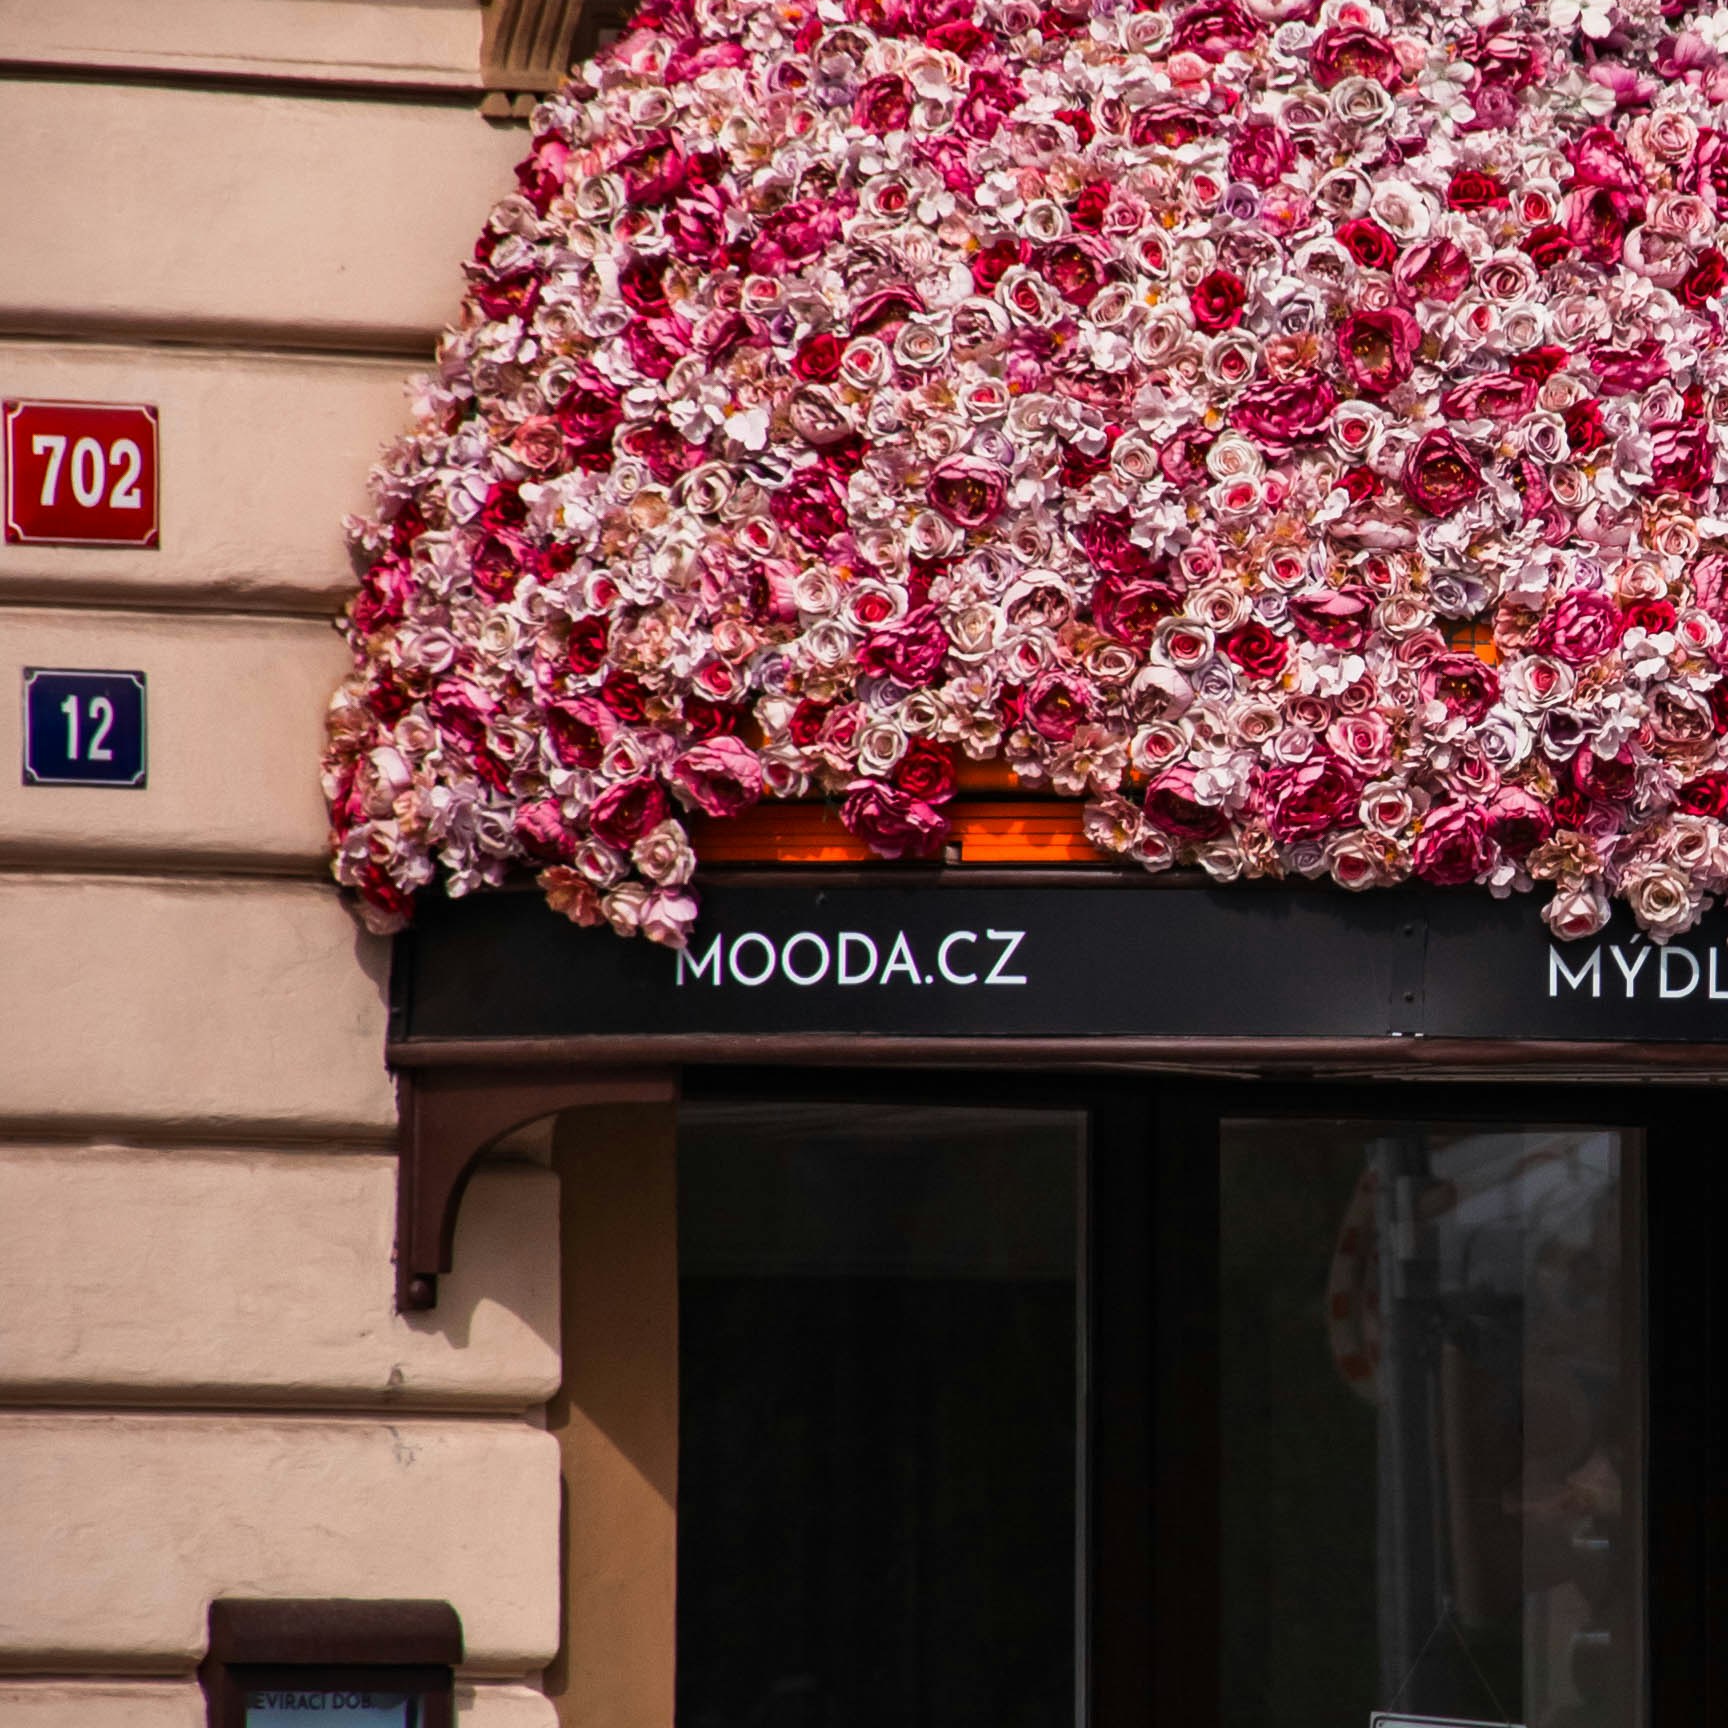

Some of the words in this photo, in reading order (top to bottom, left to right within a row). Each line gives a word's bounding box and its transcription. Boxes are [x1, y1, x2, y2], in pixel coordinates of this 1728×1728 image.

[32, 434, 142, 510] 702
[61, 694, 114, 762] 12
[676, 928, 1028, 986] MOODA.CZ
